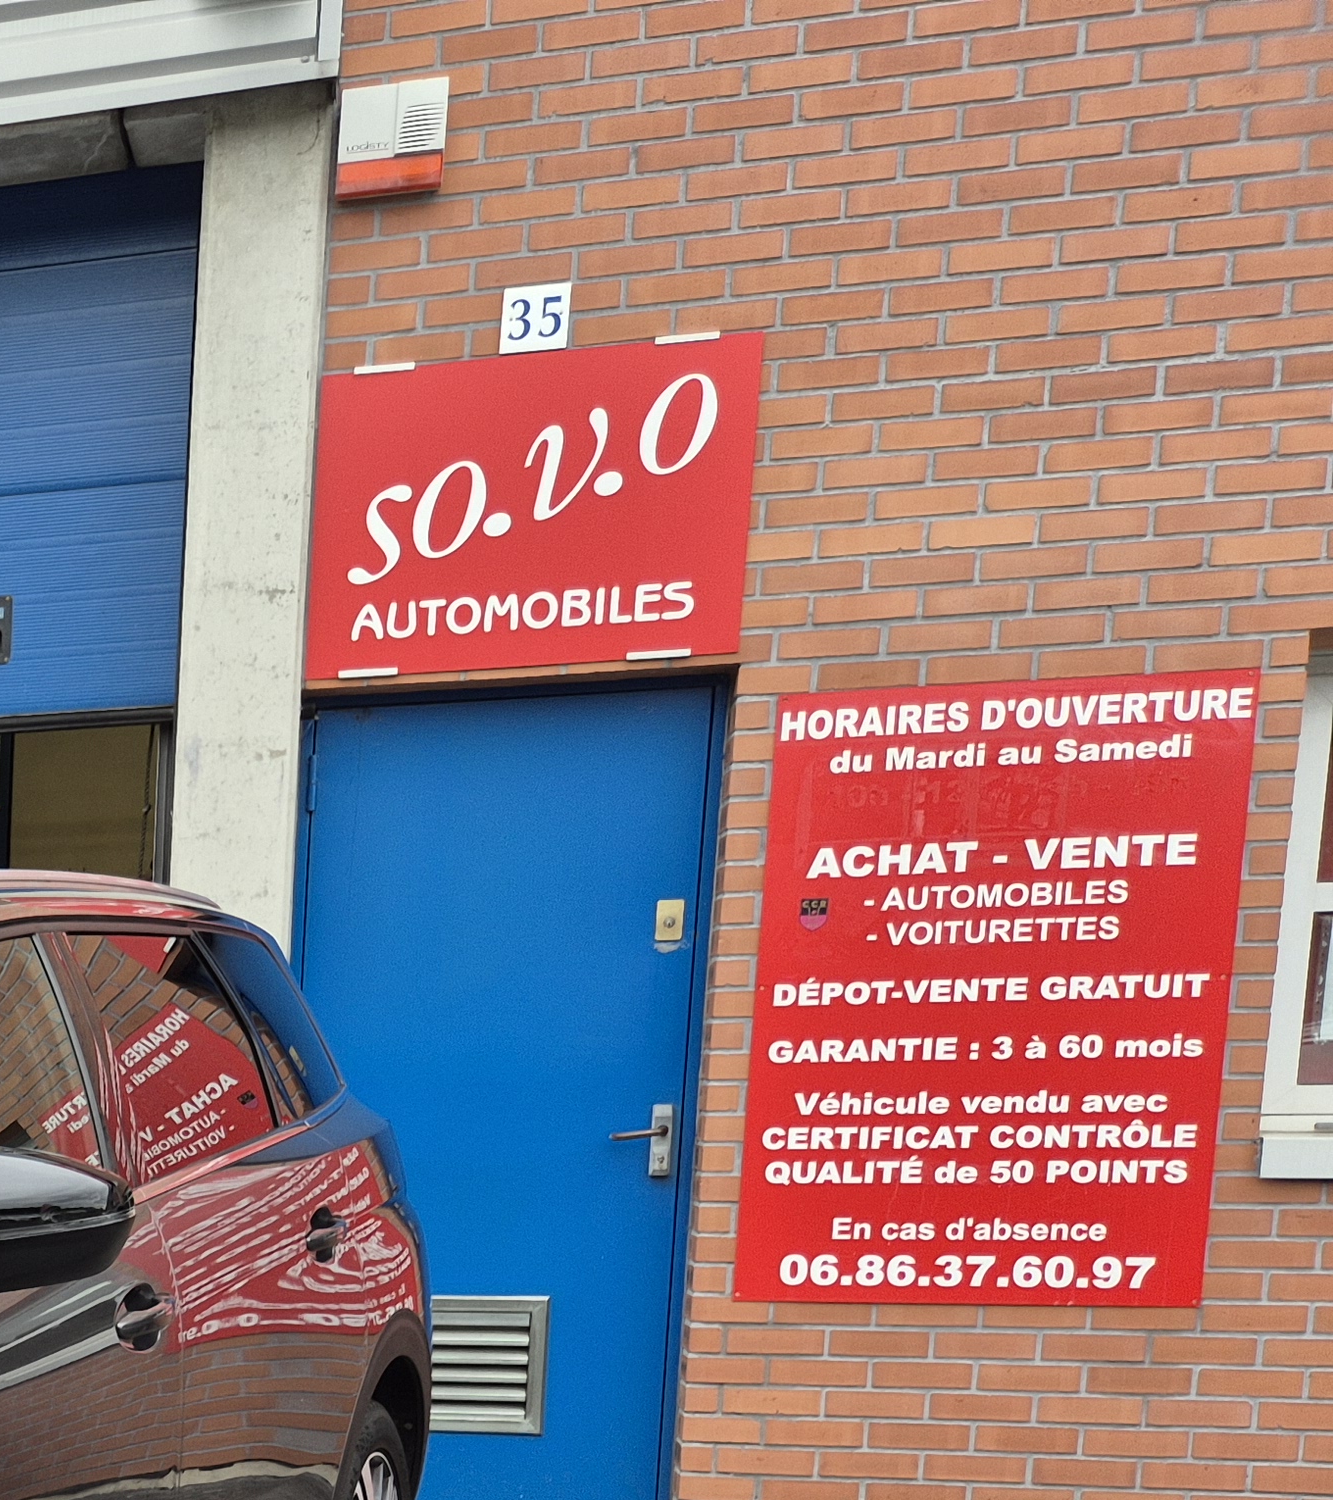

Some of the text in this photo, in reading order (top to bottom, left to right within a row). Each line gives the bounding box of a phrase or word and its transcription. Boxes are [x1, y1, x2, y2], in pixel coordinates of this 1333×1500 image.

[507, 295, 562, 341] 35
[351, 581, 695, 641] AUTOMOBILES
[780, 686, 1255, 742] HORAIRES D'OUVERTURE
[830, 733, 1193, 774] du Mardi au Samedi
[806, 840, 979, 879] ACHAT
[1024, 833, 1199, 870] VENTE
[880, 879, 1129, 912] AUTOMOBILES
[886, 915, 1120, 946] VOITURETTES
[772, 973, 1211, 1007] DÉPOT-VENTE GRATUIT
[768, 1037, 958, 1064] GARANTIE
[991, 1036, 1013, 1060] 3
[1025, 1035, 1047, 1060] à
[1059, 1034, 1104, 1059] 60
[1115, 1033, 1204, 1058] mois
[794, 1089, 1168, 1116] Véhicule vendu avec
[762, 1120, 1198, 1150] CERTIFICAT CONTRÔLE
[764, 1156, 1188, 1186] QUALITÉ de 50 POINTS
[831, 1217, 1107, 1242] En cas d'absence
[779, 1254, 1157, 1289] 06.86.37.60.97
